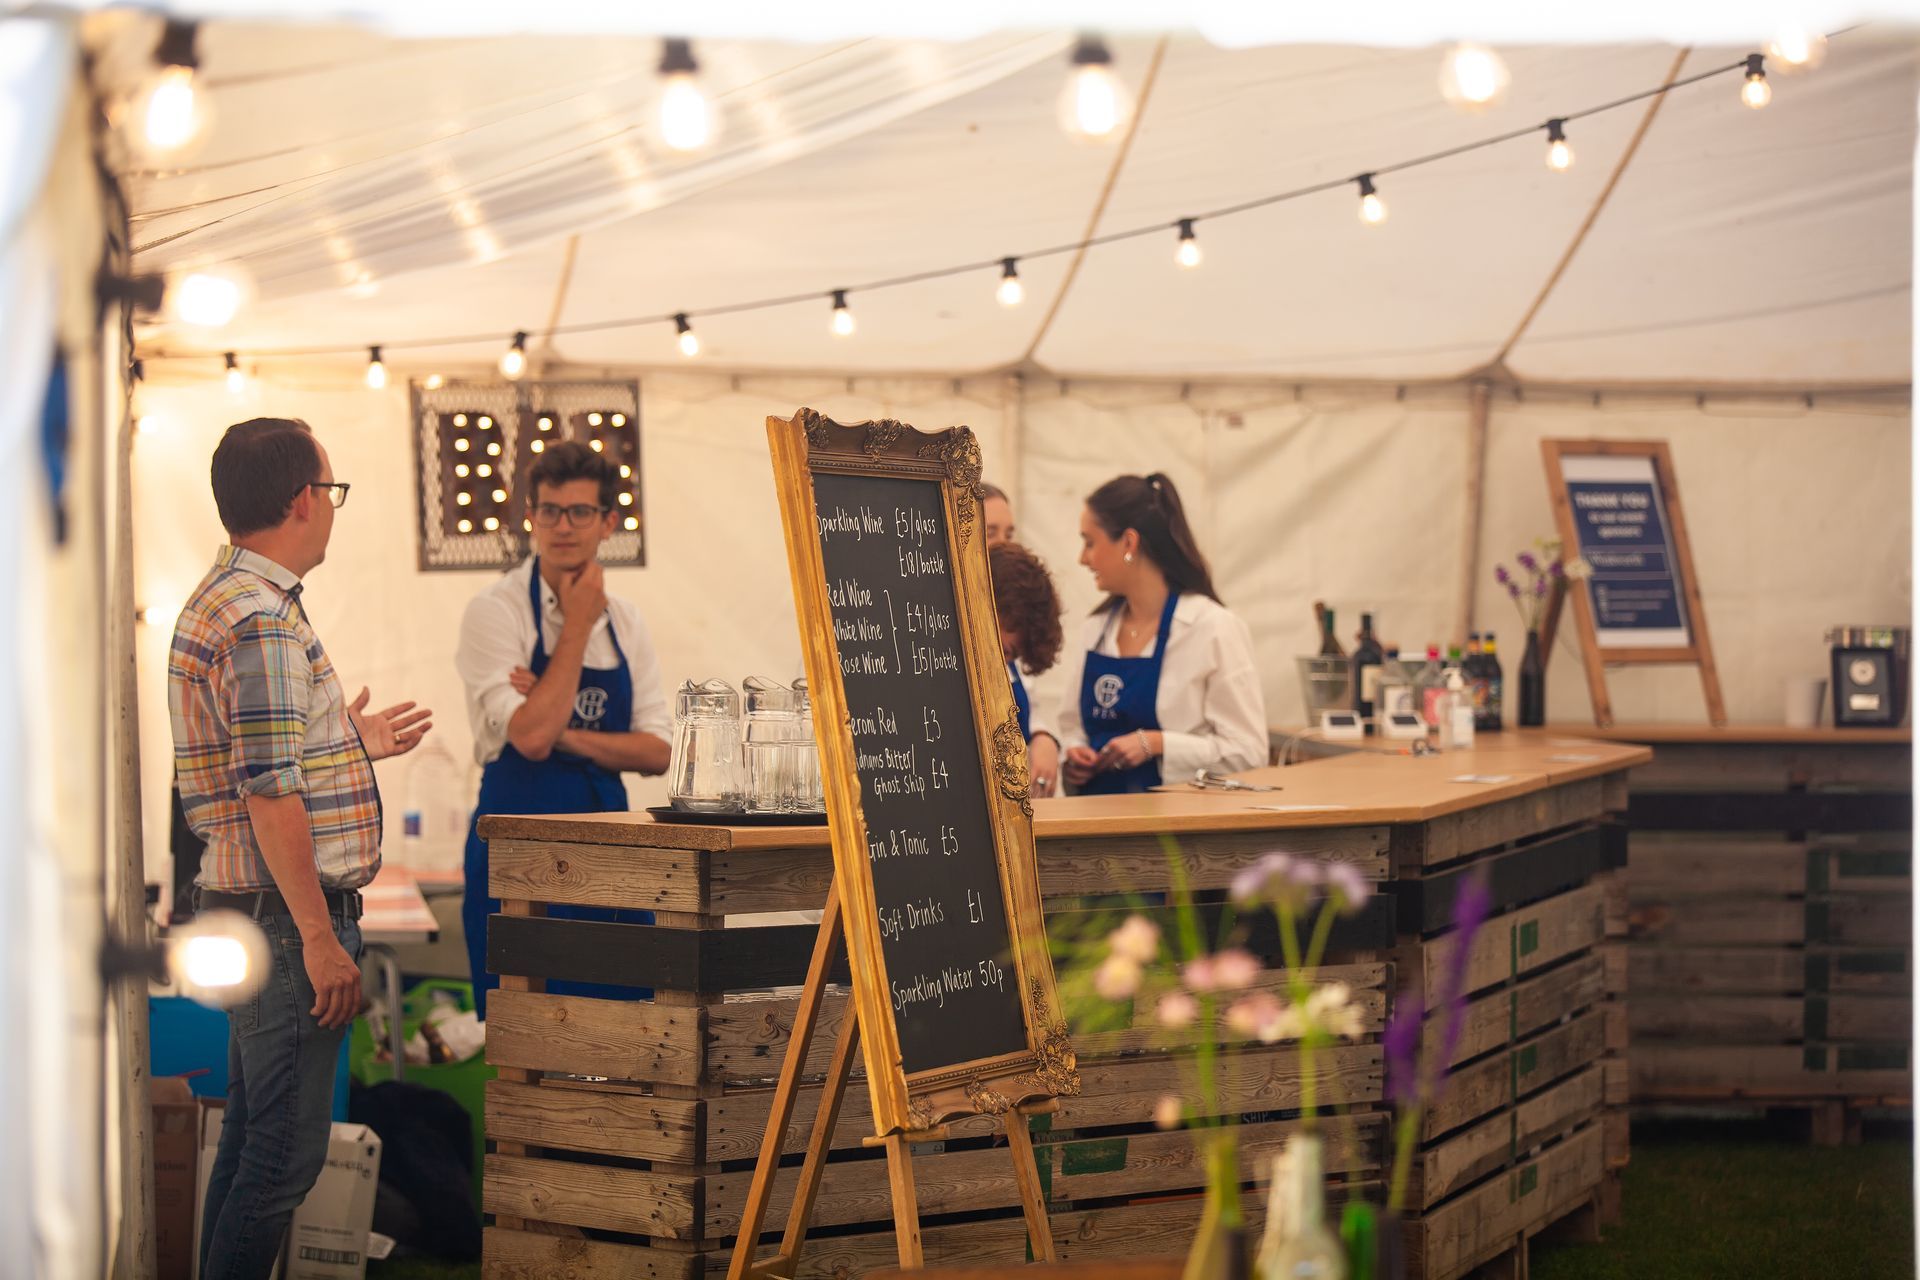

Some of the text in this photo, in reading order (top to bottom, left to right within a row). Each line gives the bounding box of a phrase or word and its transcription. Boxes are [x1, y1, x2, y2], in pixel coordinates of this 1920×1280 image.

[861, 506, 884, 534] Wine
[895, 507, 936, 547] £5/glass
[899, 546, 945, 578] £18/bottle
[846, 578, 873, 608] Wine
[857, 616, 883, 642] Wine
[906, 601, 950, 638] £4/glass
[861, 651, 888, 675] Wine
[911, 641, 958, 678] £15/bottle
[849, 706, 942, 742] eroni Red £3
[856, 744, 949, 789] dnams Bitter/ £4
[874, 774, 926, 802] Ghost Ship
[890, 829, 900, 856] &
[900, 829, 930, 856] Tonic
[941, 825, 959, 856] £5
[879, 889, 984, 941] Soft Drinks £1
[892, 959, 1003, 1017] Sparkling Water 50p
